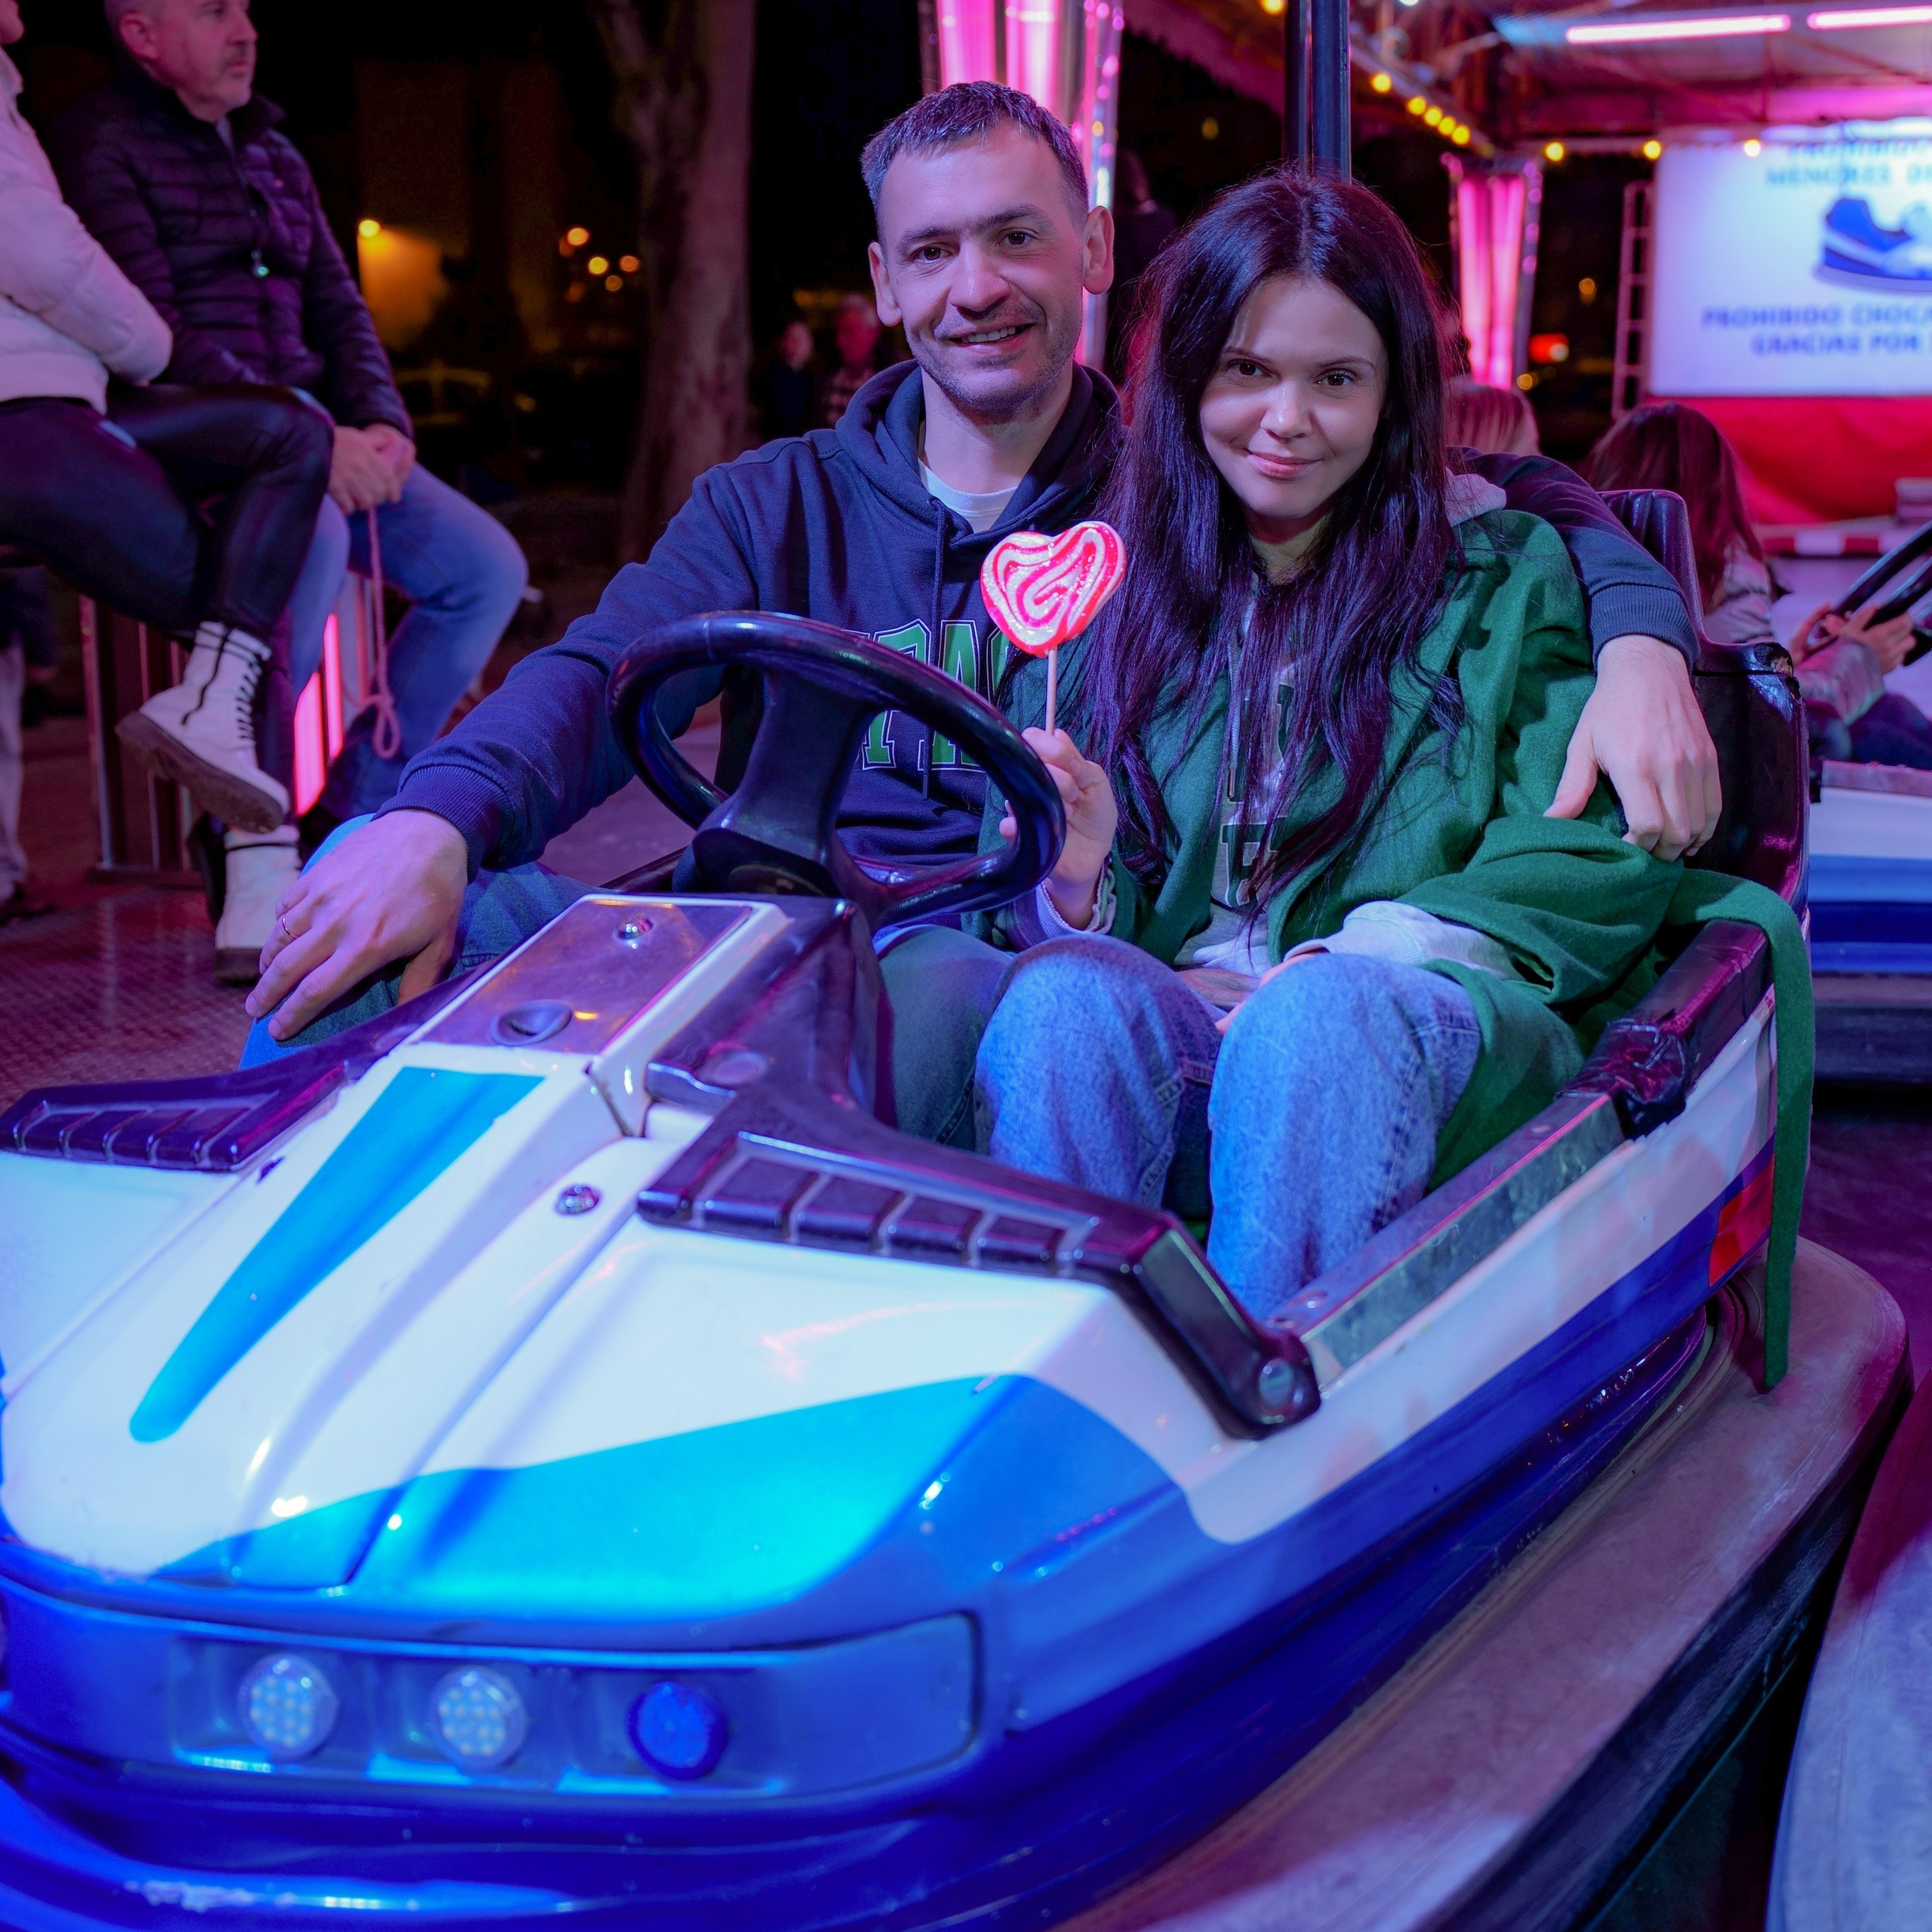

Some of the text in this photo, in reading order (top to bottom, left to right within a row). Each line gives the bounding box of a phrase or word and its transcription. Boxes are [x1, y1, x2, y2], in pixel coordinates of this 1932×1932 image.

[1703, 304, 1842, 328] PROHIBIDO
[1752, 333, 1860, 355] GRACIAS
[1870, 333, 1921, 354] POR
